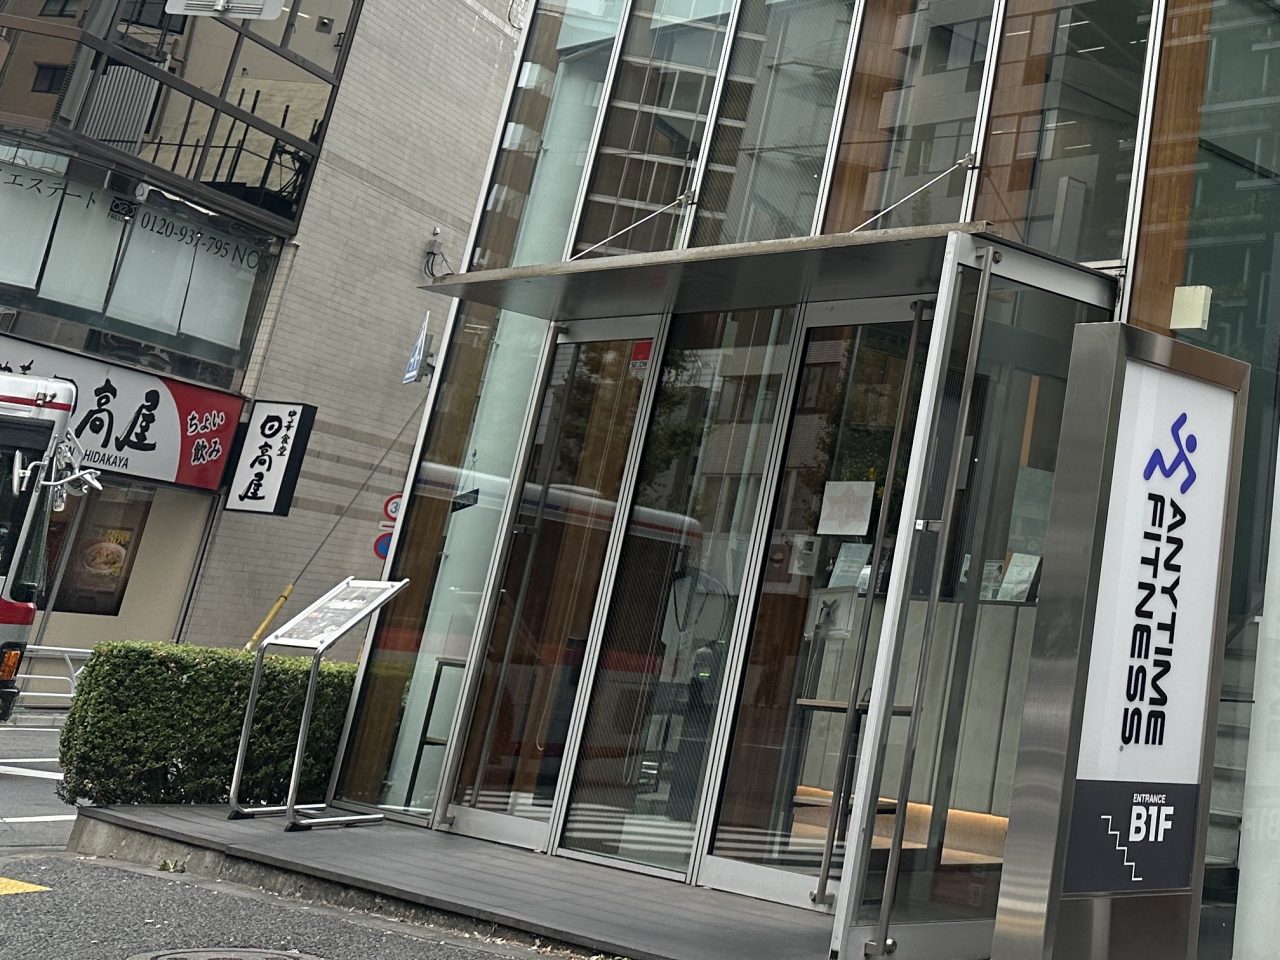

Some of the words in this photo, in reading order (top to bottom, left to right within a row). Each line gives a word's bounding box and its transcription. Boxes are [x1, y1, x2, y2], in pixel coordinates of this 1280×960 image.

[141, 212, 229, 258] 0120-937-795
[187, 410, 226, 437] ちょい
[83, 450, 130, 470] HIDAKAYA
[191, 438, 222, 466] 飲み
[239, 415, 283, 502] 日高屋
[1121, 492, 1166, 747] FITNESS
[1145, 497, 1187, 746] ANYTIME
[1133, 793, 1167, 804] ENTRANCE
[1128, 805, 1175, 842] B1F
